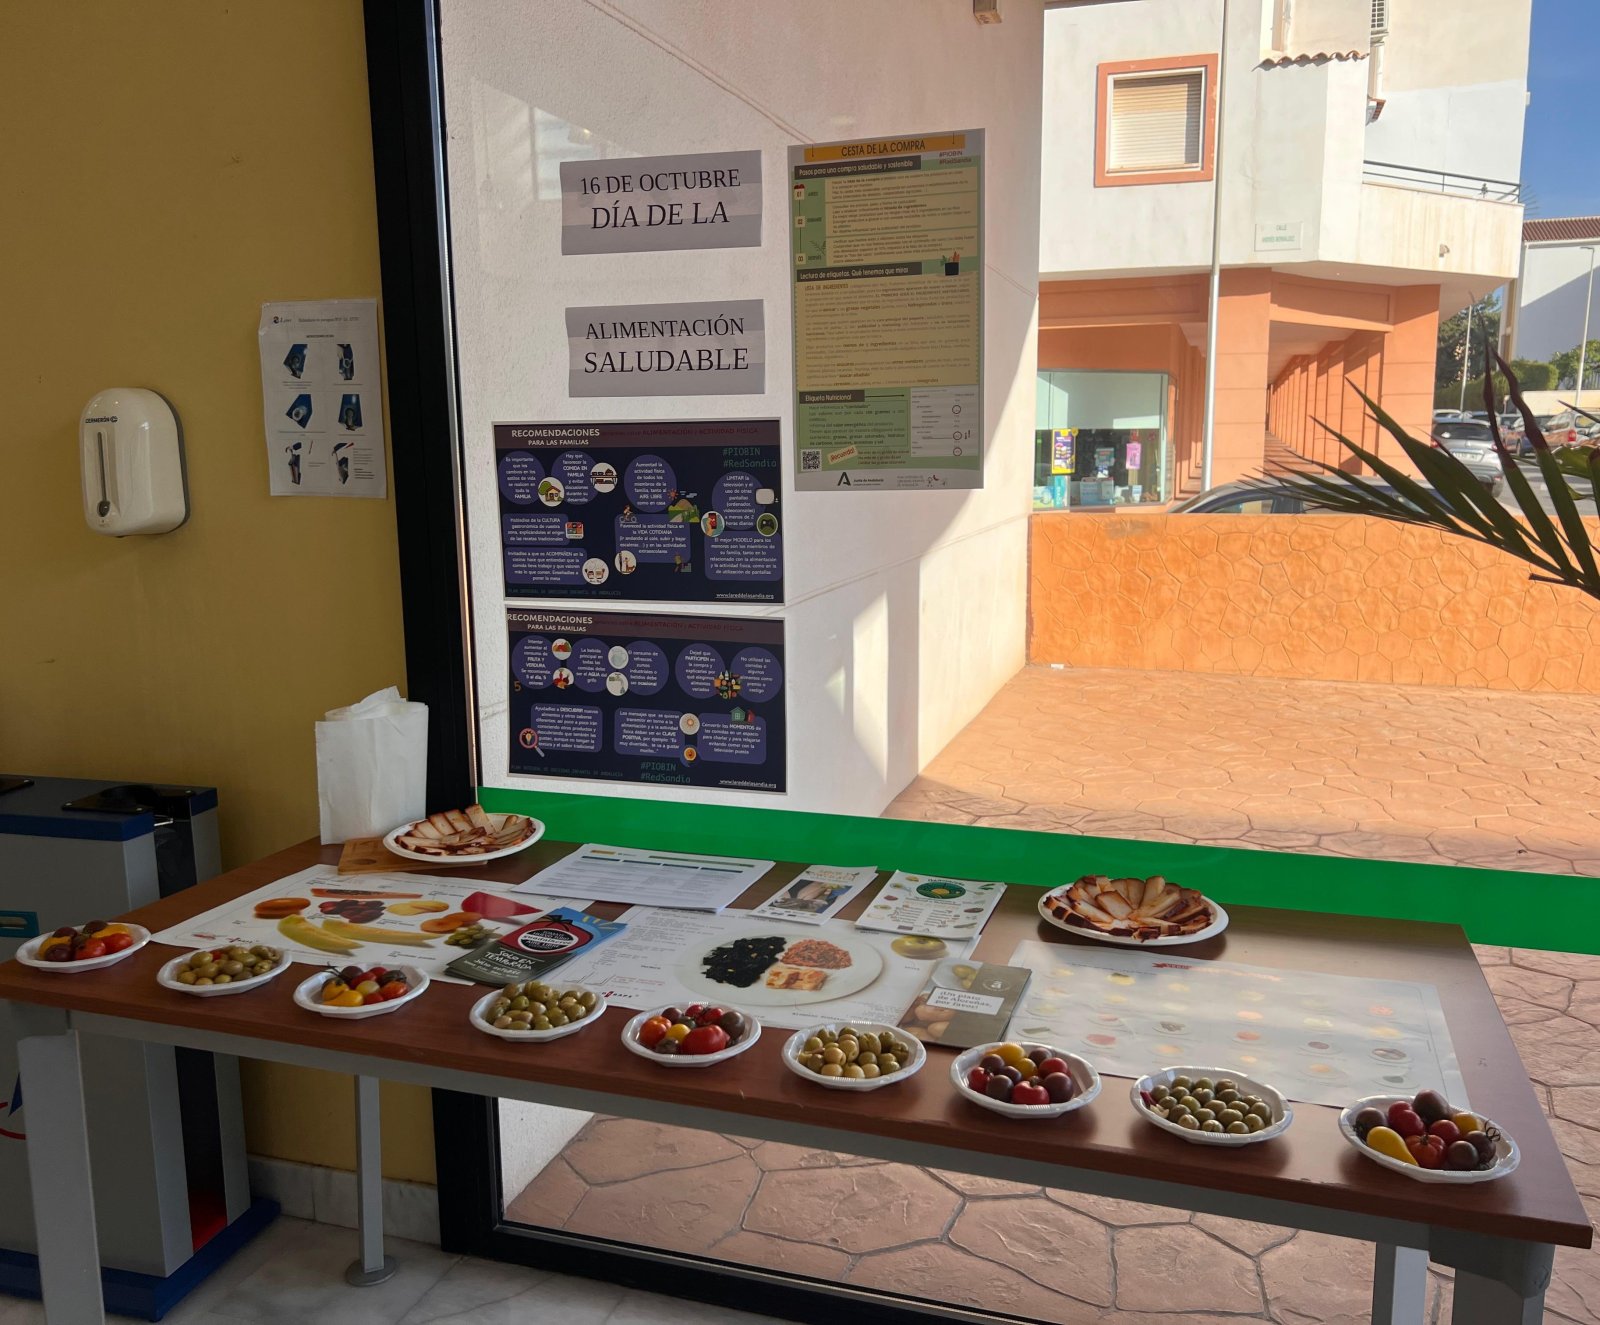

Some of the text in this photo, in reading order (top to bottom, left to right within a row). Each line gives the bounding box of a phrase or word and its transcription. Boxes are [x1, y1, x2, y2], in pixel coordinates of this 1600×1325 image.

[841, 139, 926, 157] CESTA DE LA COMPRA
[799, 168, 814, 176] Pasos
[858, 163, 882, 171] saludable
[887, 160, 913, 169] sostenible
[580, 168, 741, 195] 16 DE OCTUBRE
[591, 200, 730, 229] DÍA DE LA
[826, 270, 850, 279] etiquetas.
[851, 268, 861, 276] Qué
[586, 314, 745, 340] ALIMENTACIÓN
[584, 348, 749, 373] SALUDABLE
[511, 428, 600, 438] RECOMENDACIONES
[722, 447, 761, 456] #PIOBIN
[507, 613, 593, 624] RECOMENDACIONES
[514, 680, 522, 692] 5
[640, 761, 677, 771] #PIOBIN
[952, 1001, 979, 1010] favor!
